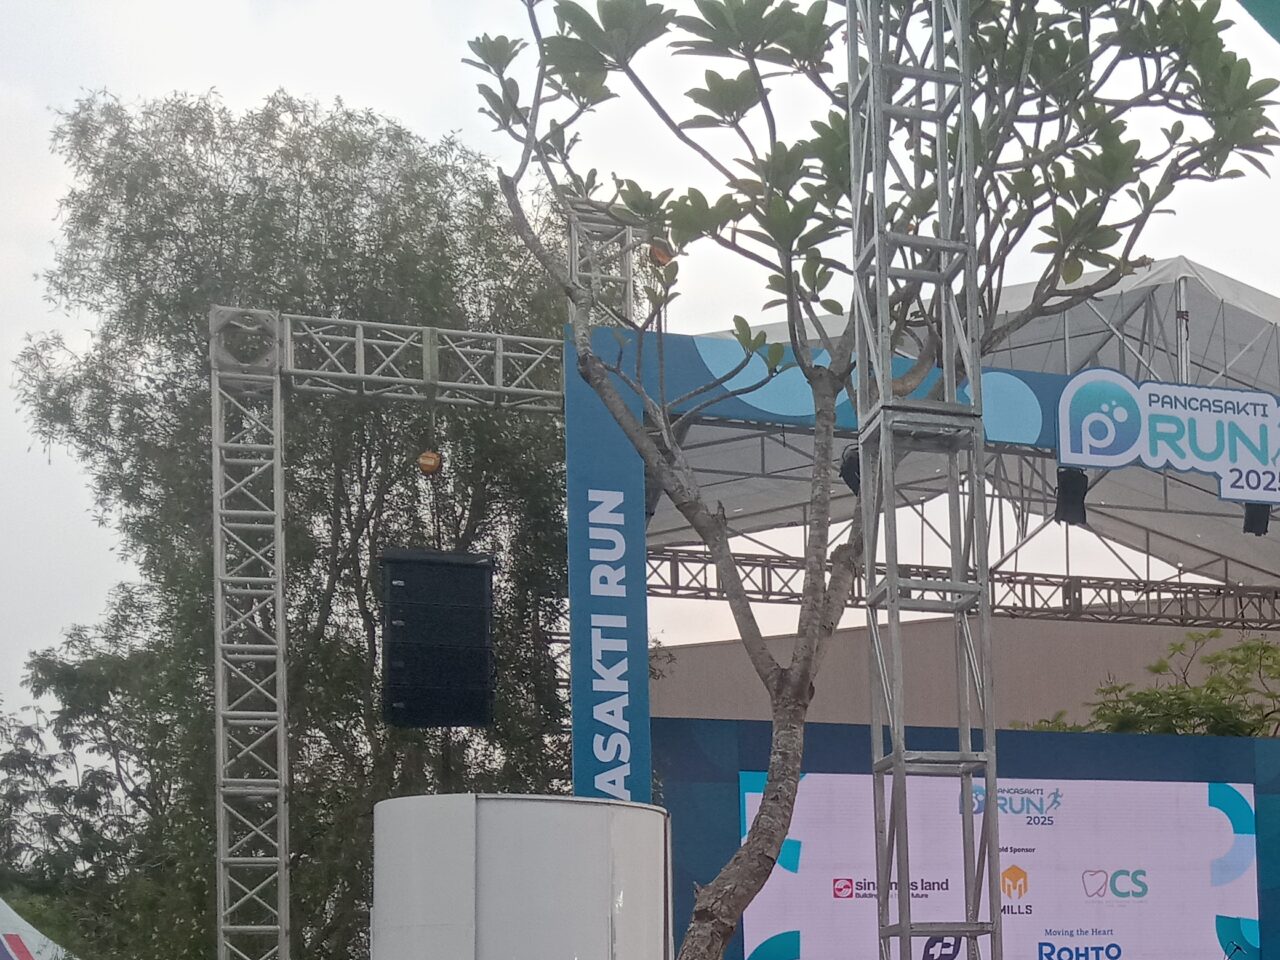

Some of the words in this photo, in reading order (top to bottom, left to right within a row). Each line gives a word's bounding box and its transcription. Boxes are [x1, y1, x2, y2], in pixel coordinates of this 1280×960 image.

[1148, 393, 1269, 418] PANCASAKTI
[1150, 414, 1269, 466] RUN
[587, 488, 627, 598] RUN
[589, 613, 632, 801] ASAKTI
[998, 787, 1043, 796] ANCASAKTI
[997, 796, 1044, 815] RUN
[1025, 815, 1054, 826] 2025
[1010, 846, 1036, 854] Sponsor
[921, 878, 949, 891] land
[1109, 869, 1149, 898] CS
[1044, 928, 1074, 938] Moving
[1076, 928, 1089, 936] the
[1091, 928, 1114, 936] Heart
